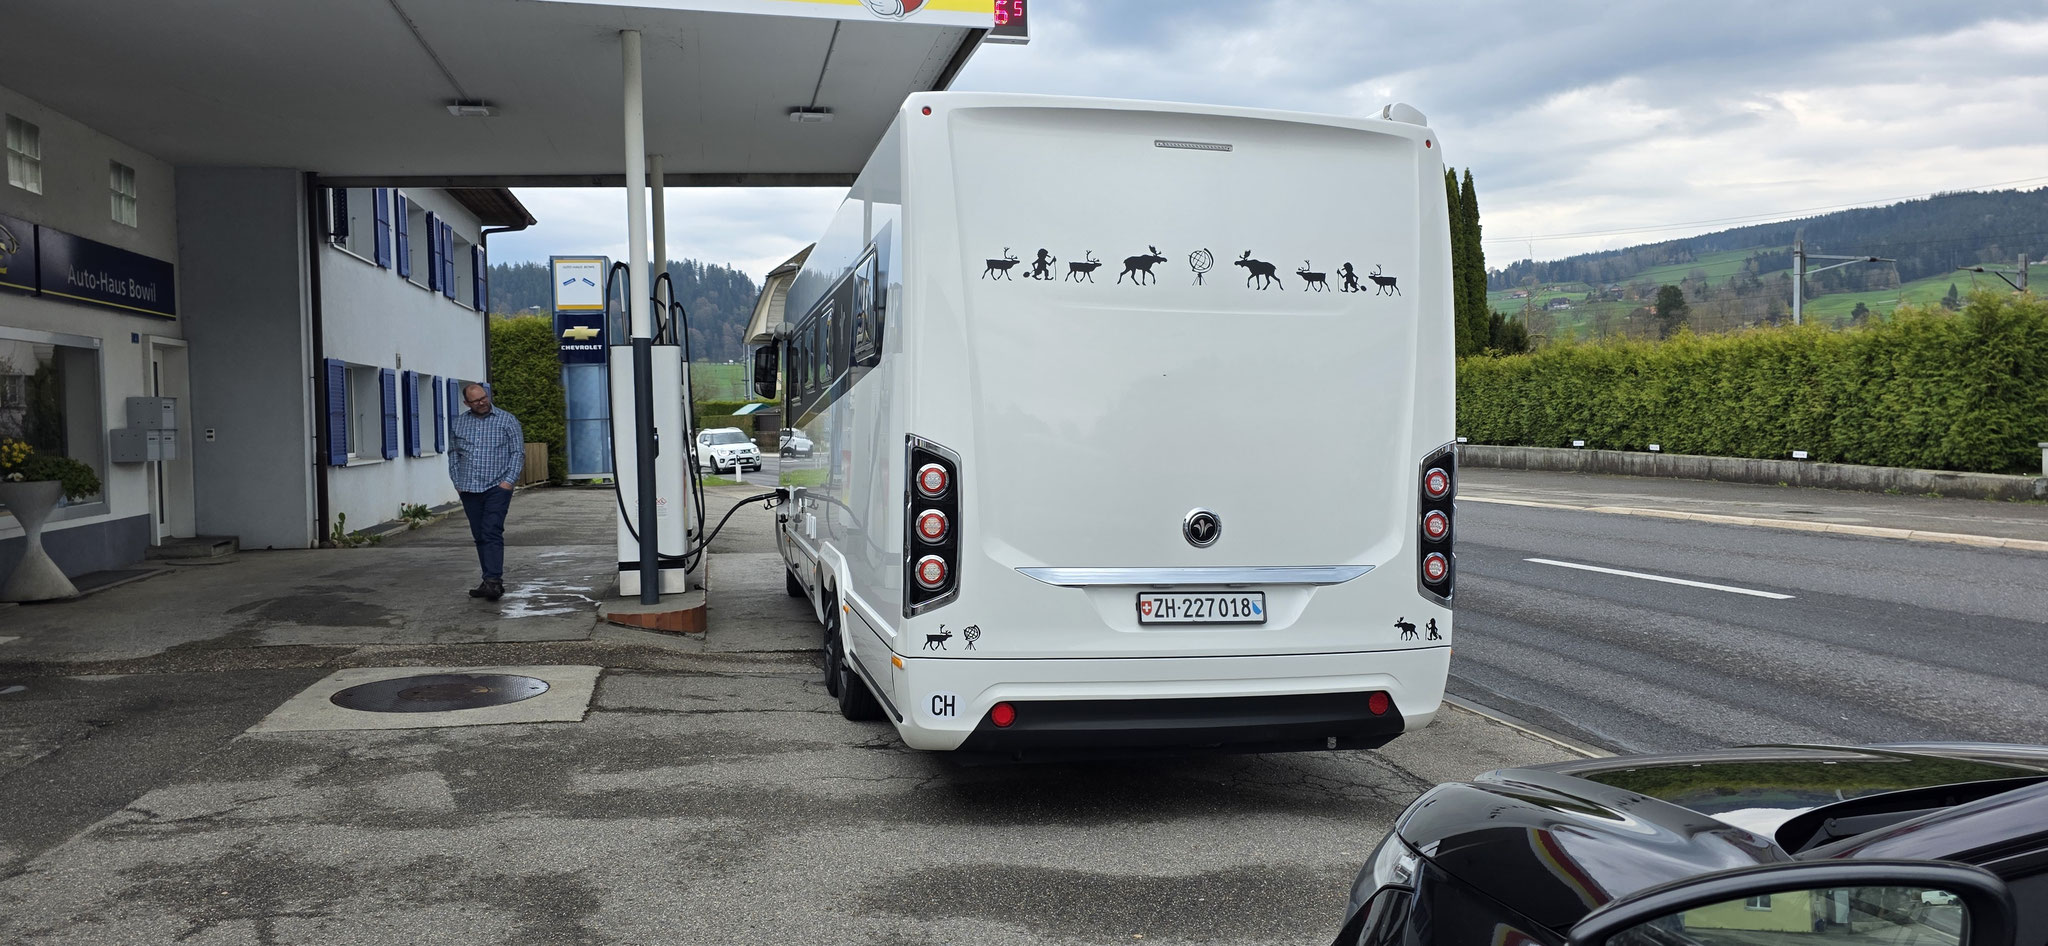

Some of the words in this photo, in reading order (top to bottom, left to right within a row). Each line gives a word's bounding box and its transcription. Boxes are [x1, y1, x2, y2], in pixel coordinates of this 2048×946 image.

[68, 264, 127, 296] Auto-Haus
[129, 278, 157, 302] Bowil
[932, 695, 955, 716] CH
